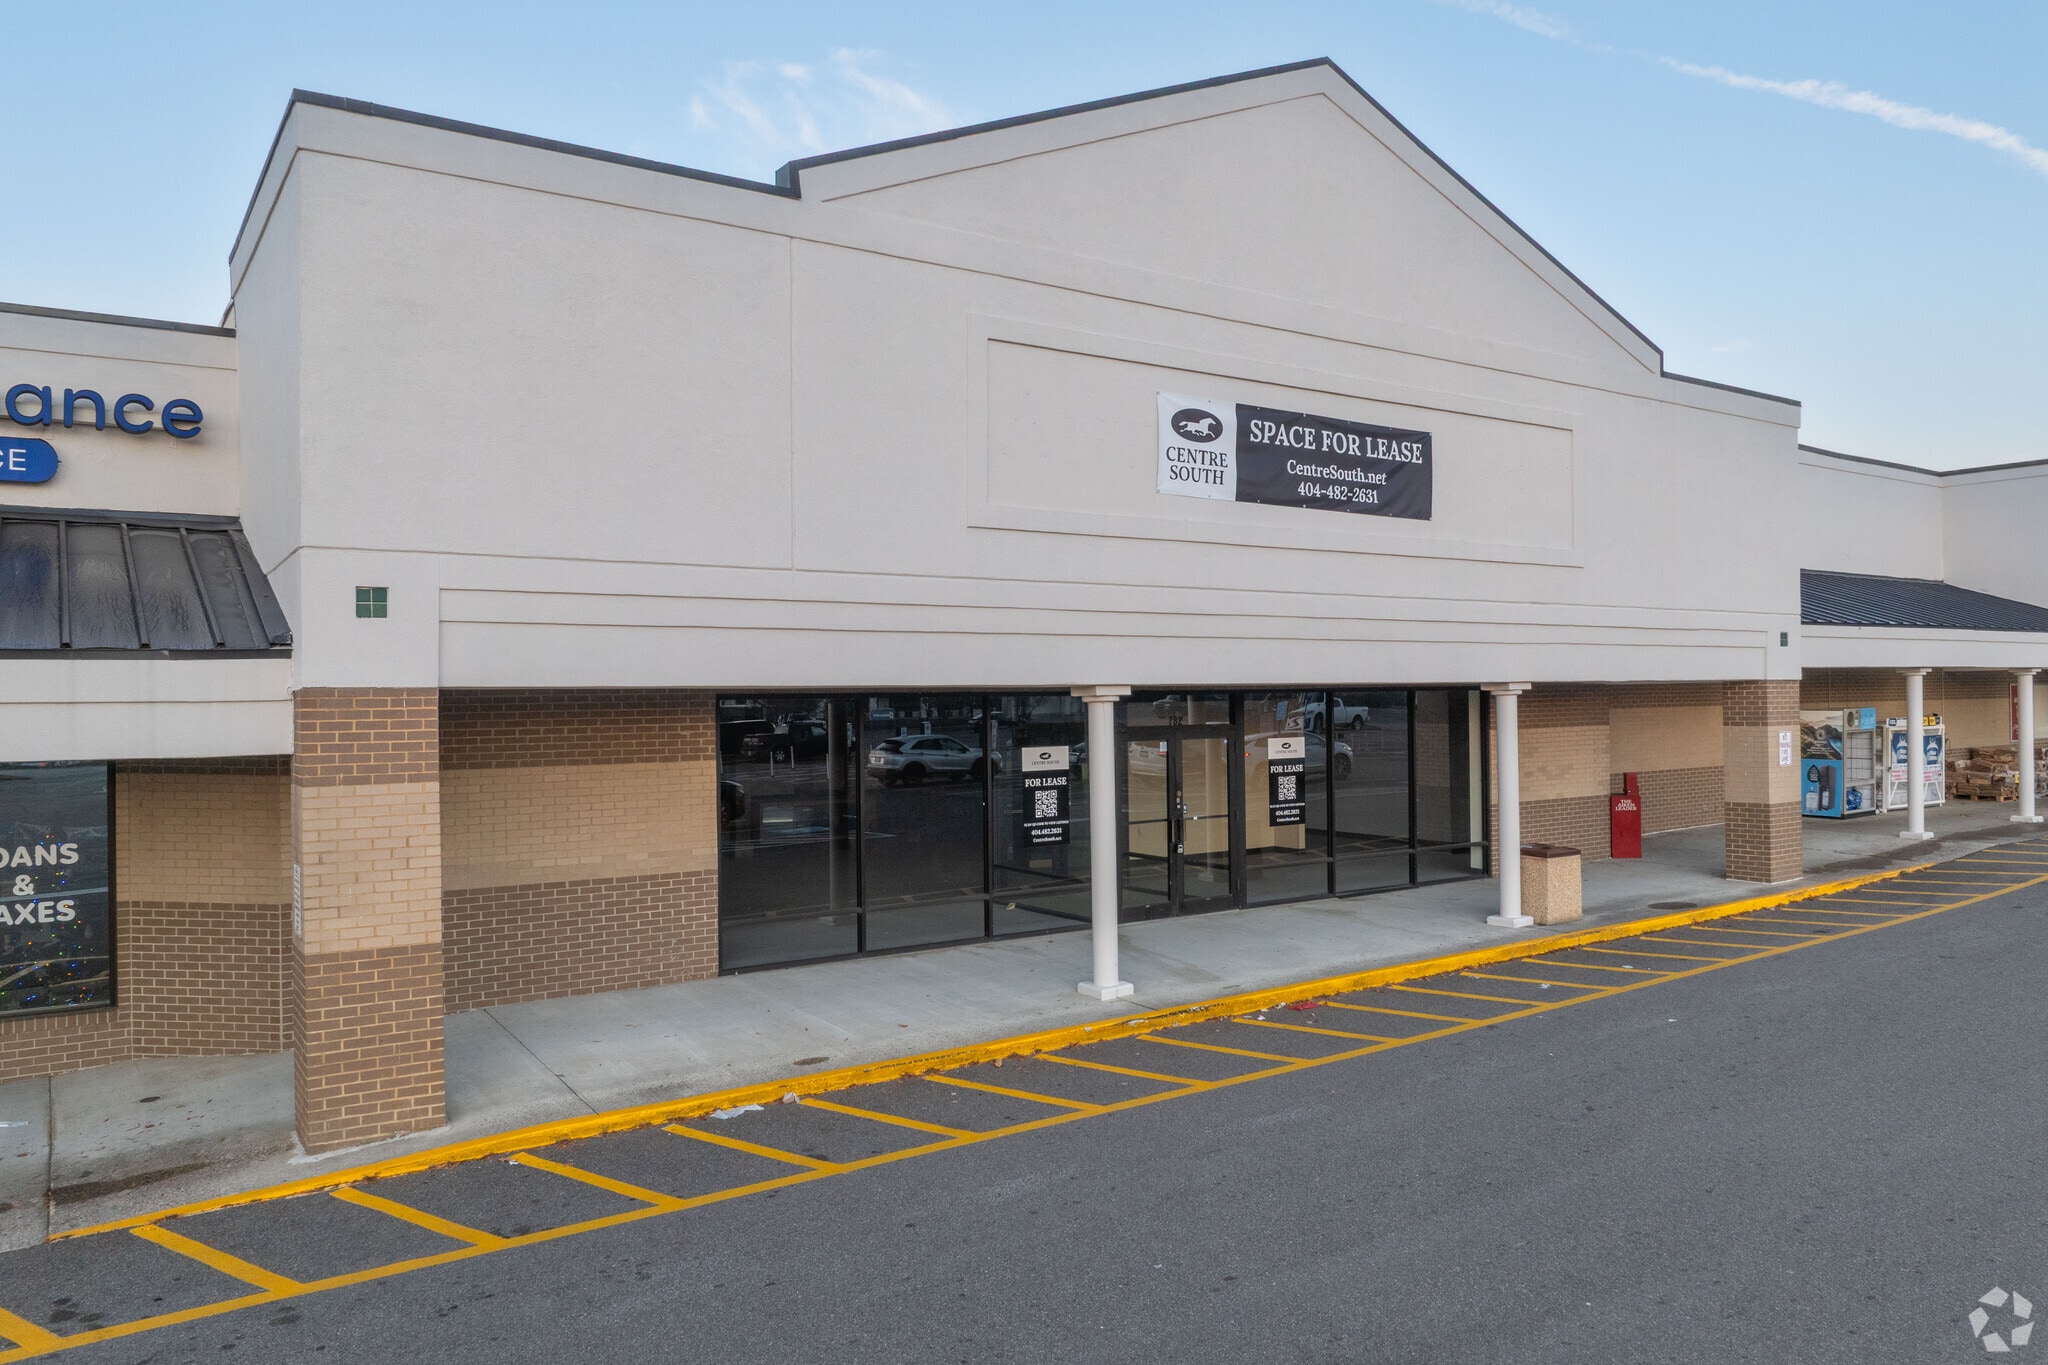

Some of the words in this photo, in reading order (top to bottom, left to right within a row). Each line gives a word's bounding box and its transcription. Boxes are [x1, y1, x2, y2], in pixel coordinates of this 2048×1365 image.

[5, 384, 203, 438] ance
[1250, 420, 1316, 450] SPACE
[1322, 430, 1361, 456] FOR
[1366, 437, 1422, 464] LEASE
[0, 448, 26, 471] E
[1166, 446, 1228, 468] CENTRE
[1170, 465, 1224, 485] SOUTH
[1287, 460, 1387, 485] CentreSouth.net
[1298, 482, 1378, 504] 404-482-2631
[1025, 779, 1041, 787] FOR
[1043, 777, 1067, 786] LEASE
[12, 874, 34, 896] &
[0, 900, 76, 925] AXES
